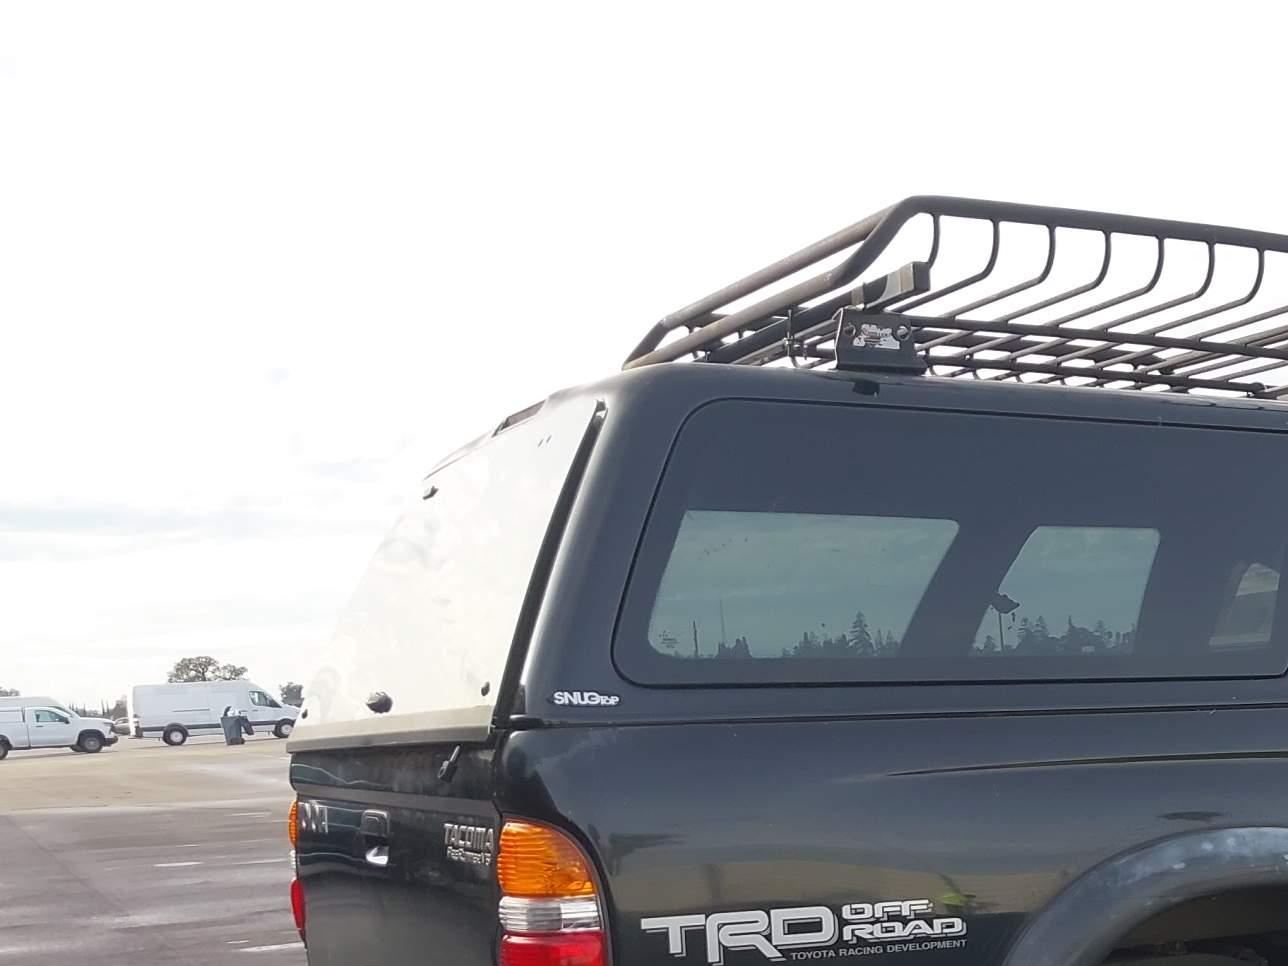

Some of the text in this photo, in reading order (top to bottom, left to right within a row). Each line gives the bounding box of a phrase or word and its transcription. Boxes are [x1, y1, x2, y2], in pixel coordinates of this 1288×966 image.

[444, 823, 494, 851] TACOMA
[842, 899, 933, 921] OFF
[641, 905, 838, 966] TRD
[843, 917, 967, 944] ROAD
[790, 939, 967, 961] TOYOTA RACING DEVELOPMENT
